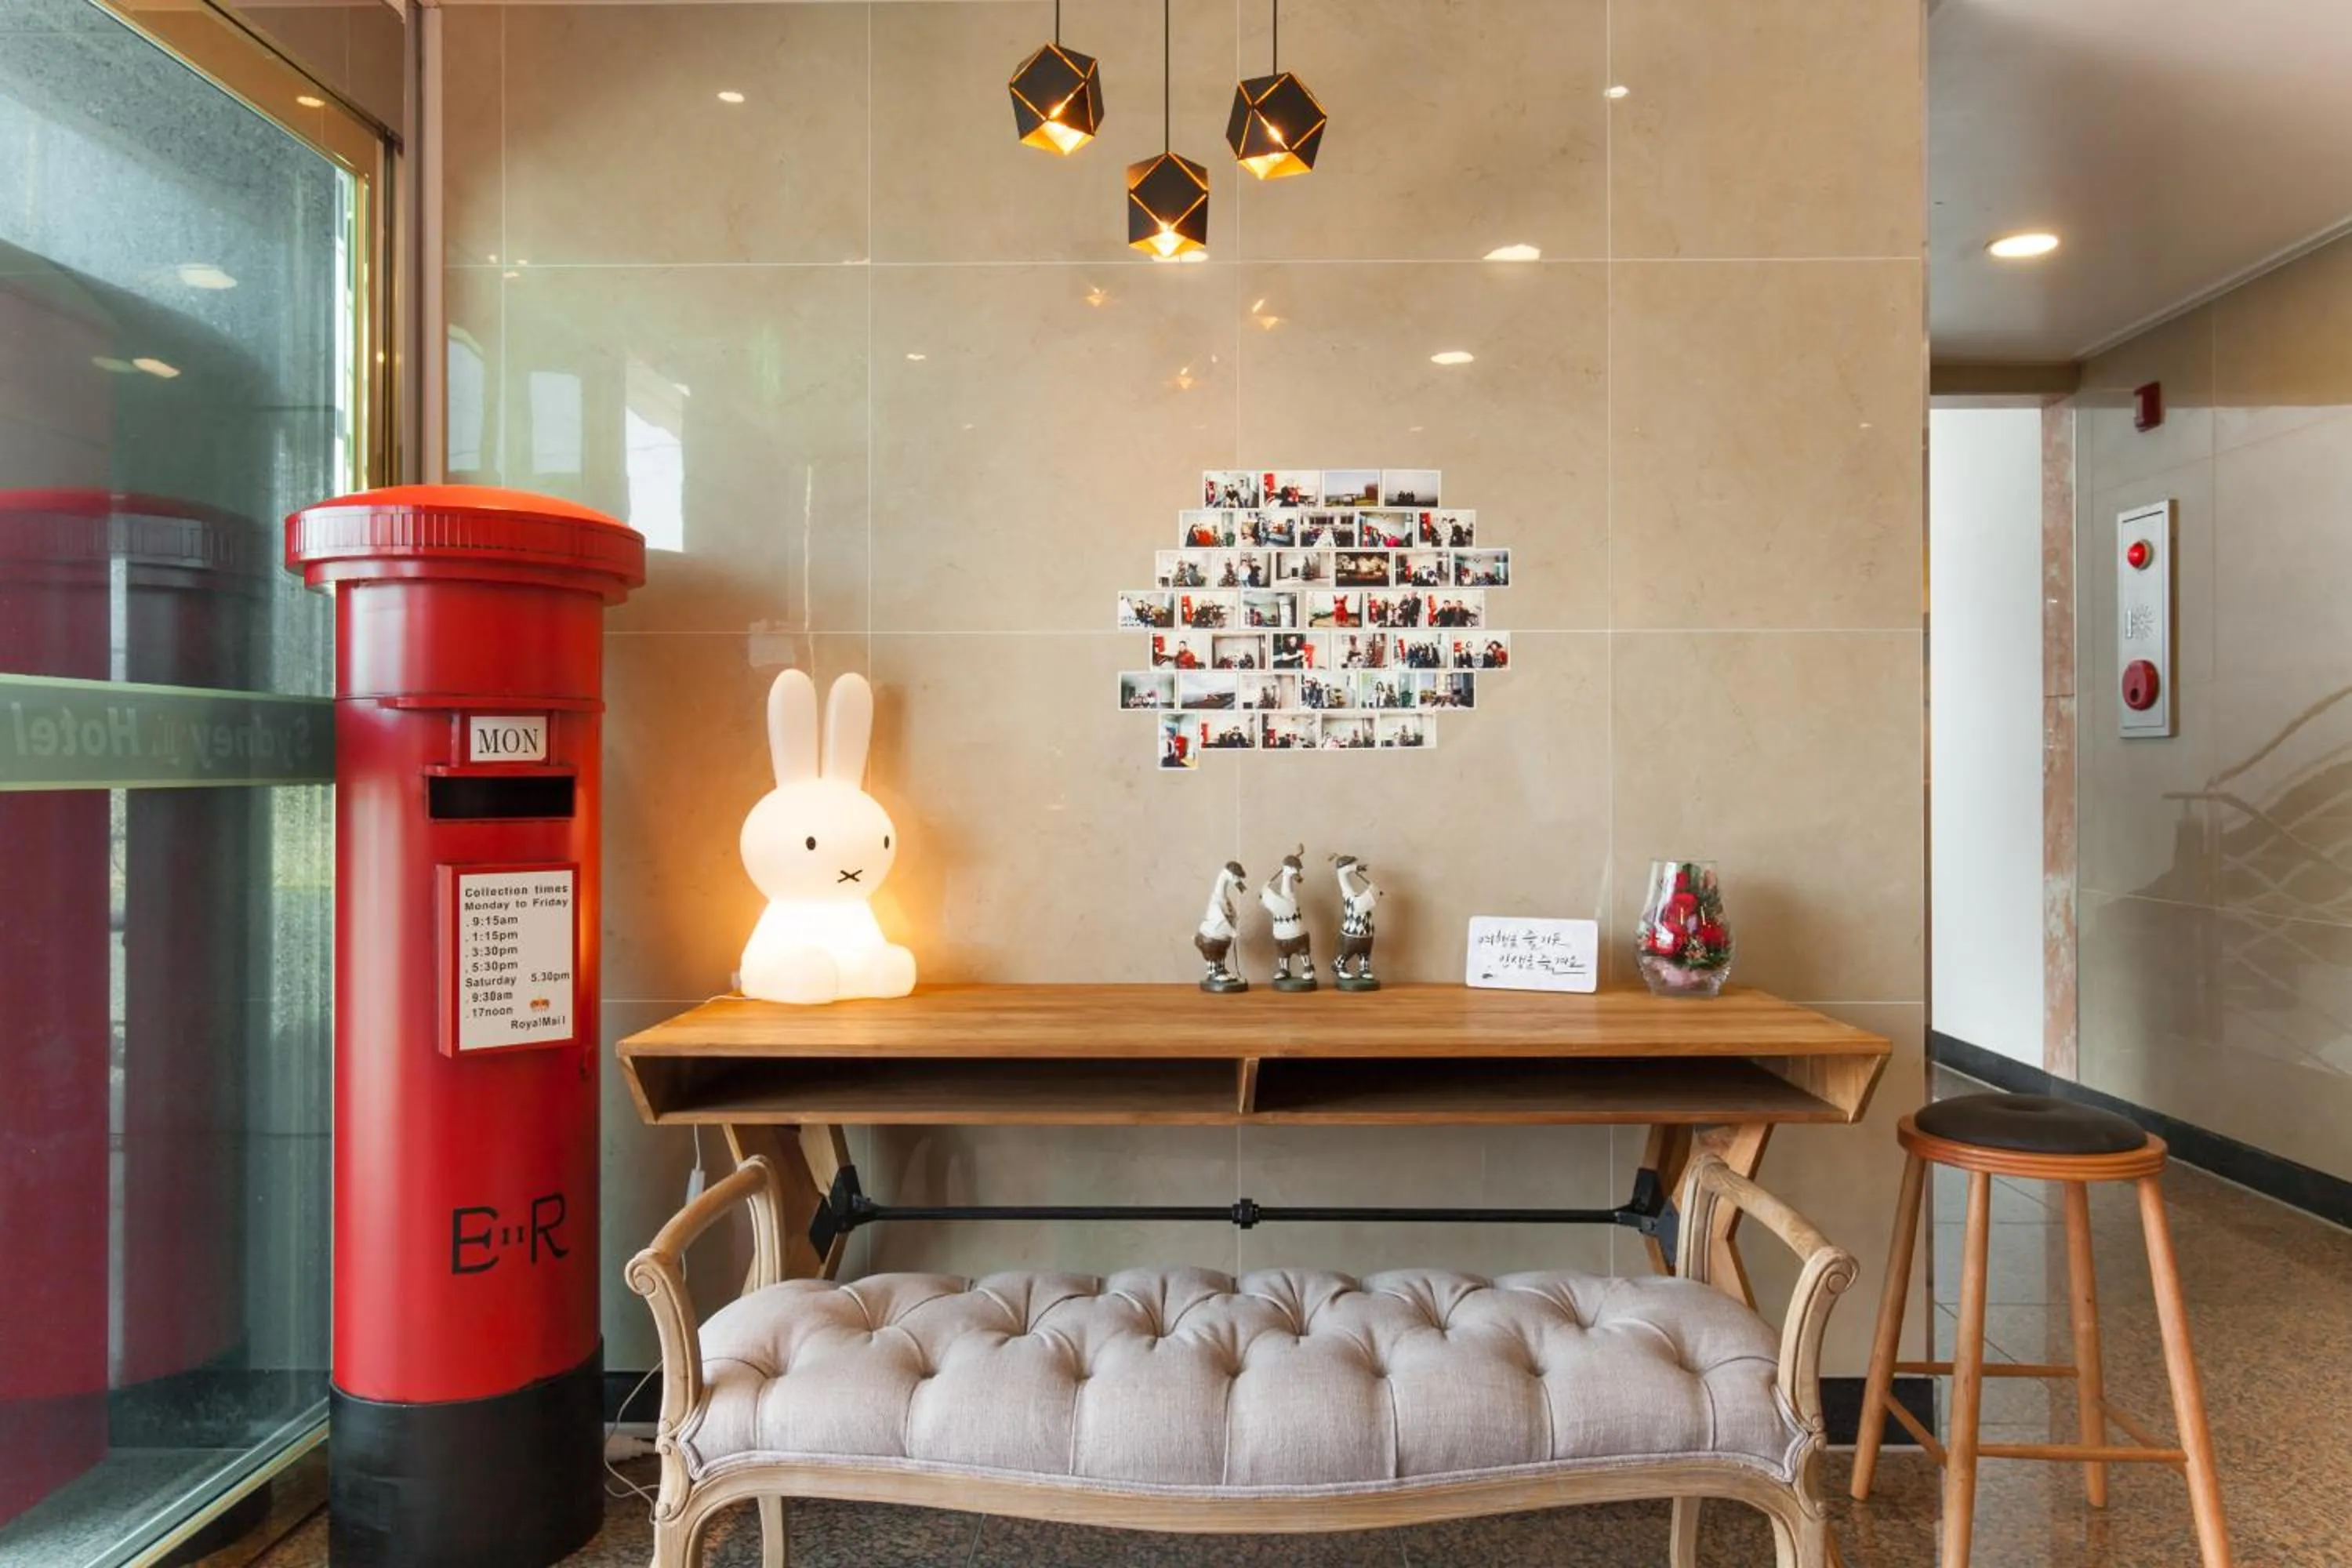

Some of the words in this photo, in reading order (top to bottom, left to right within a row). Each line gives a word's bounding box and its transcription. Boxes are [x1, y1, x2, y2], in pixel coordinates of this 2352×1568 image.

[477, 728, 539, 753] MON
[465, 886, 528, 898] Collection
[535, 885, 569, 895] times
[464, 900, 510, 911] Monday
[515, 899, 528, 908] to
[532, 898, 569, 908] Friday
[465, 976, 517, 988] Saturday
